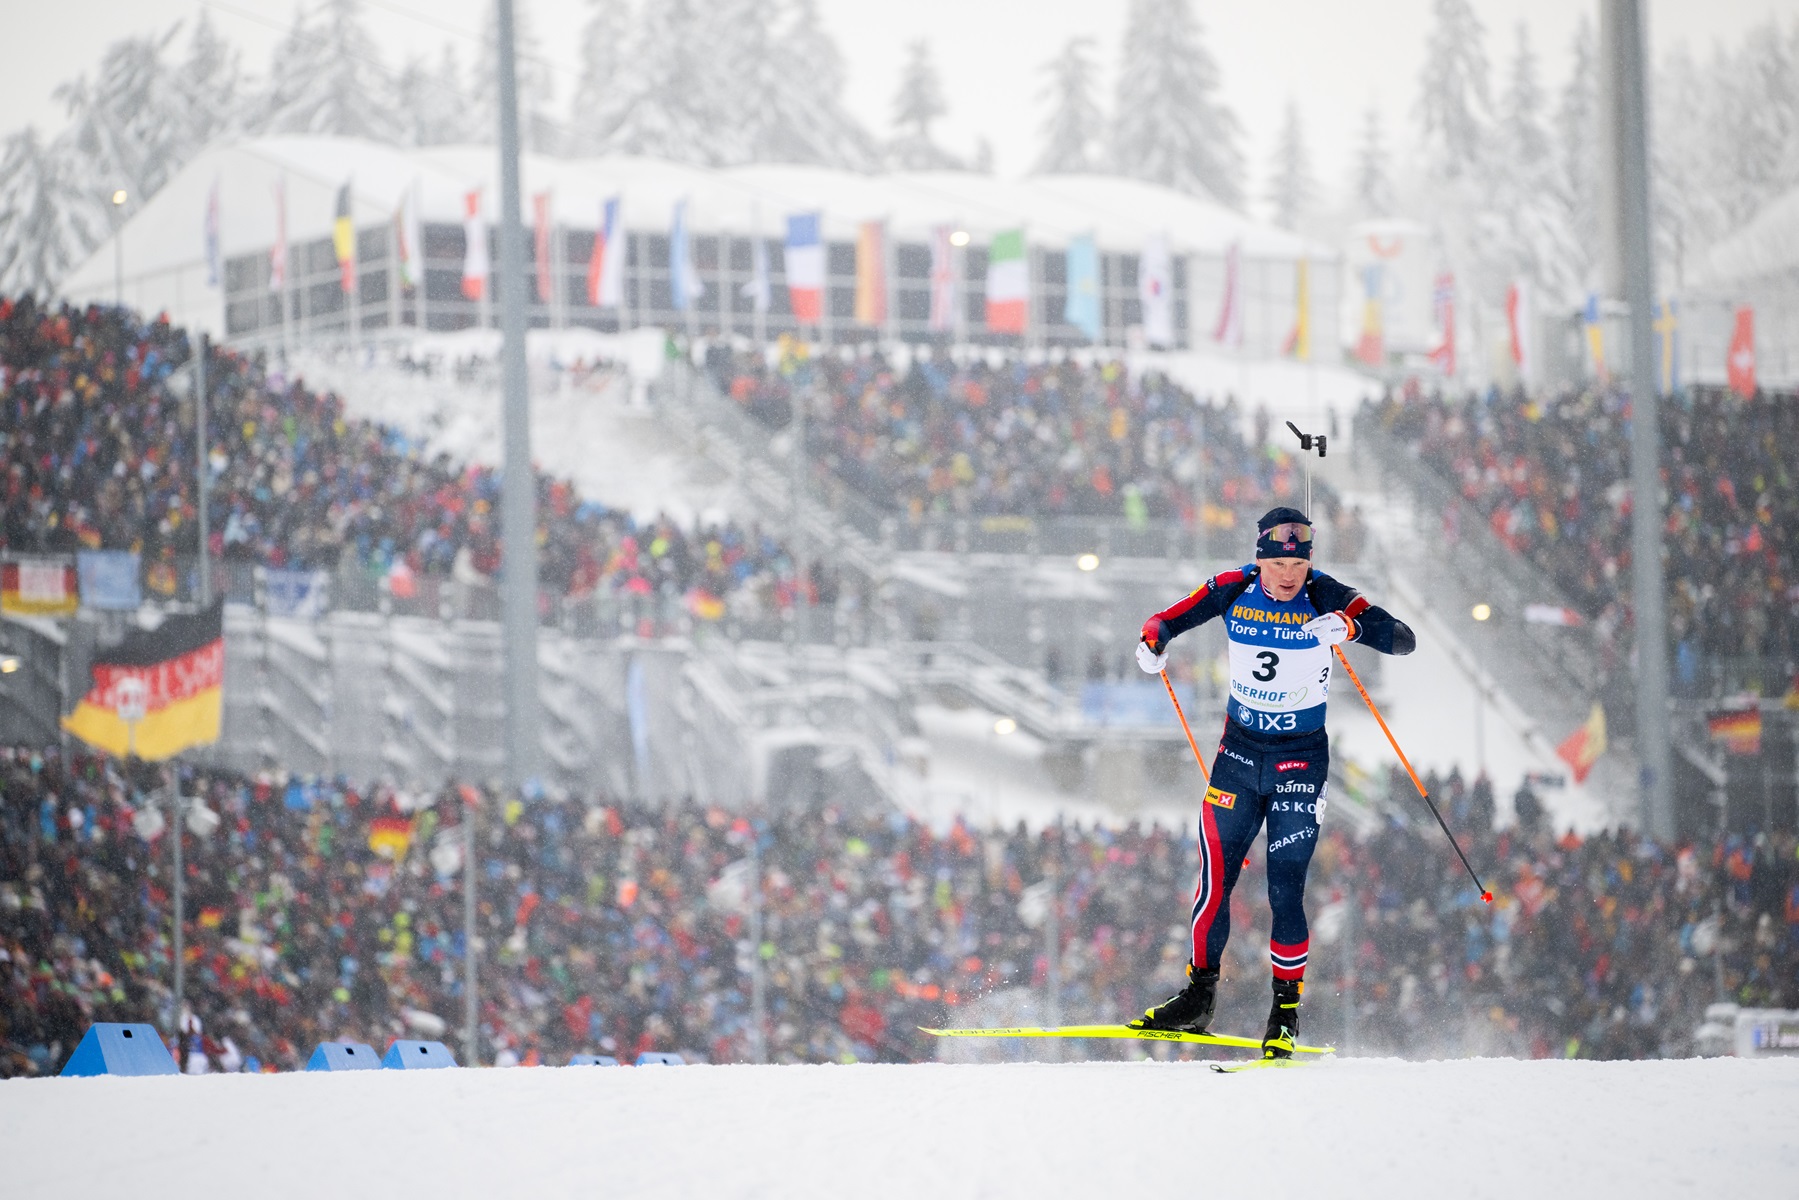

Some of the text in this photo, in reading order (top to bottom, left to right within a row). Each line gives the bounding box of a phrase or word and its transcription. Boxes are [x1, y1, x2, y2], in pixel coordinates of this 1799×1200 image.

[1230, 620, 1313, 640] Tore Türen
[1252, 651, 1280, 682] 3
[1319, 667, 1329, 683] 3
[1232, 679, 1288, 702] OBERHOF
[1258, 713, 1297, 731] iX3
[1224, 748, 1254, 767] LAPUA
[1278, 762, 1306, 771] MENY
[1268, 830, 1306, 853] CRAFT
[1137, 1030, 1183, 1040] FISCHER
